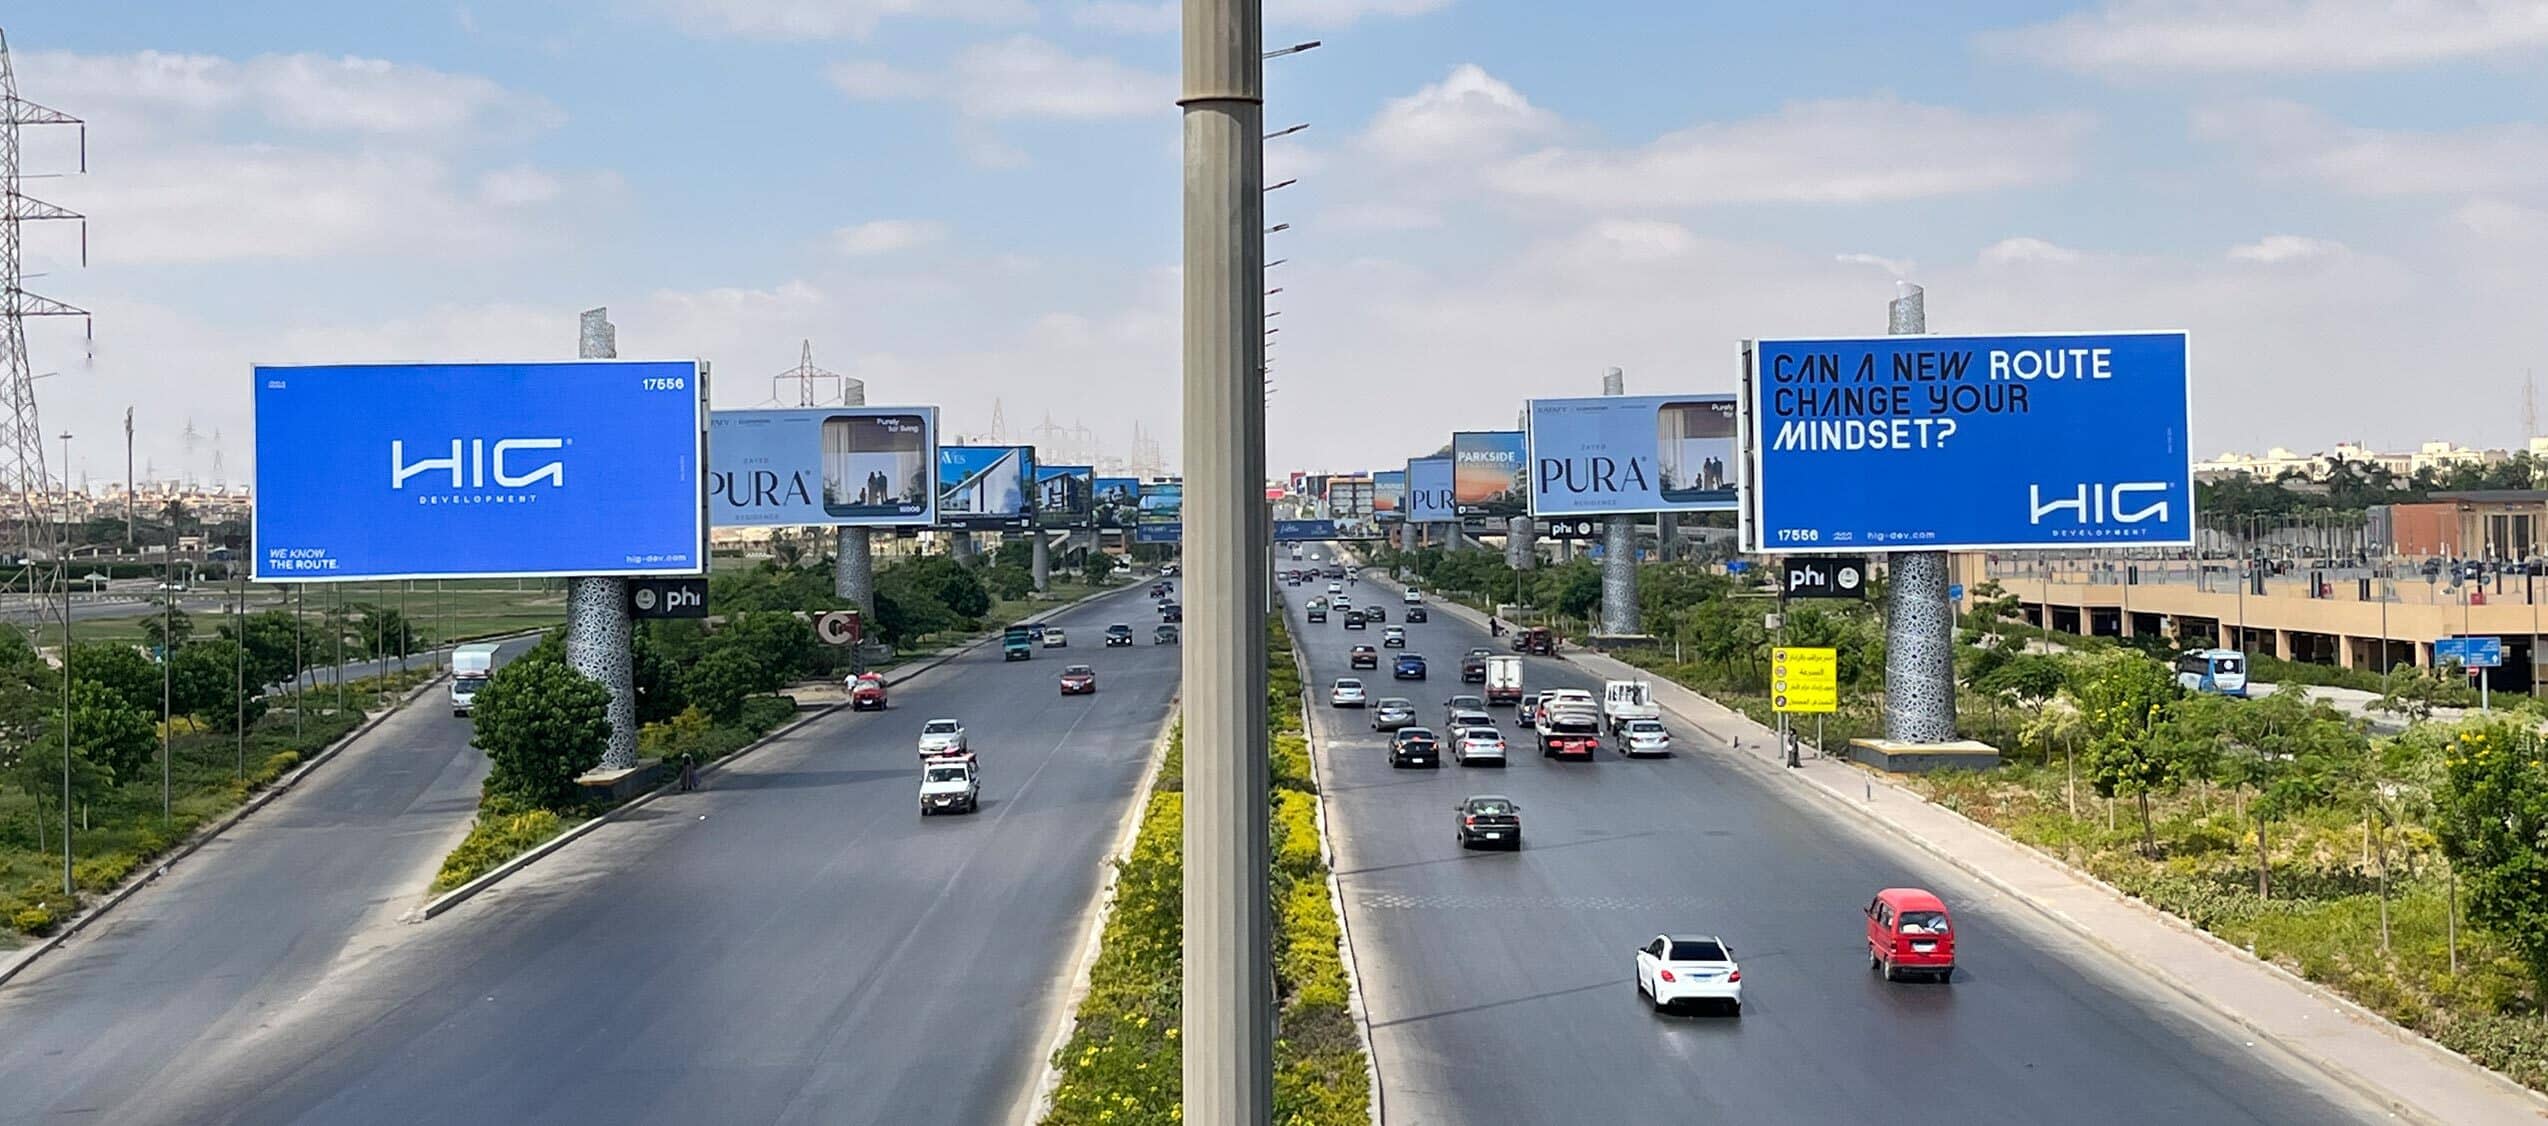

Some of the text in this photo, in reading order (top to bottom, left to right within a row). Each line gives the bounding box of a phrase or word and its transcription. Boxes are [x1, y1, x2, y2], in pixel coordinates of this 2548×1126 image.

[1774, 349, 2112, 383] CAN A NEW ROUTE
[642, 377, 685, 390] 17556
[1775, 383, 2029, 417] CHANGE YOUR
[876, 418, 900, 426] Purely
[1773, 418, 1957, 451] MINDSET?
[1458, 450, 1516, 462] PARKSIDE
[392, 438, 563, 489] HIG
[1540, 456, 1648, 494] PURA
[419, 494, 537, 505] DEVELOPMENT
[2030, 482, 2168, 524] HIG
[1777, 529, 1819, 542] 17556
[1867, 531, 1935, 541] hig-dev.com
[2052, 528, 2147, 537] DEVELOPMENT
[270, 548, 326, 558] WE KNOW
[269, 559, 339, 569] THE ROUTE.
[1790, 564, 1825, 592] phi
[666, 584, 700, 613] phi
